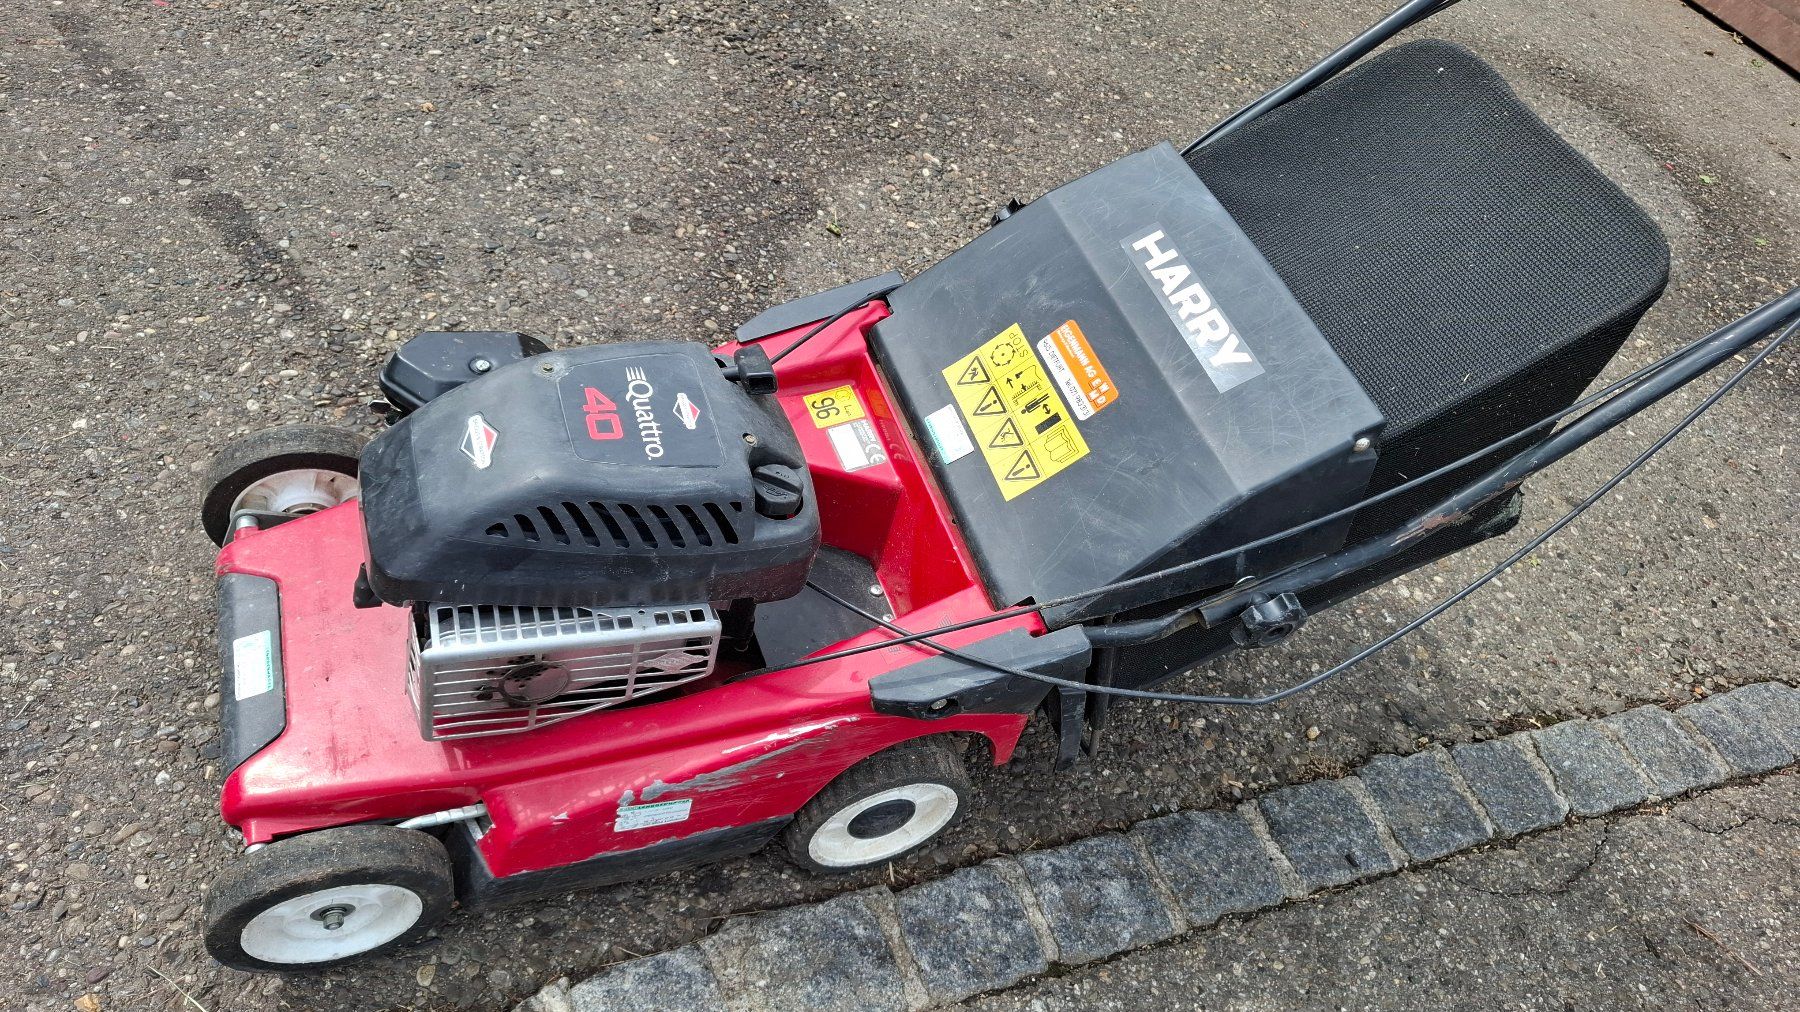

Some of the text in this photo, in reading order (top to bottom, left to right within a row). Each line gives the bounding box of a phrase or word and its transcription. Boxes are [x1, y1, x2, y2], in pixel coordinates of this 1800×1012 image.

[1131, 229, 1253, 367] HARRY
[1008, 332, 1029, 358] STOP
[1083, 363, 1098, 380] AG
[582, 387, 624, 440] 40
[811, 397, 840, 420] 96
